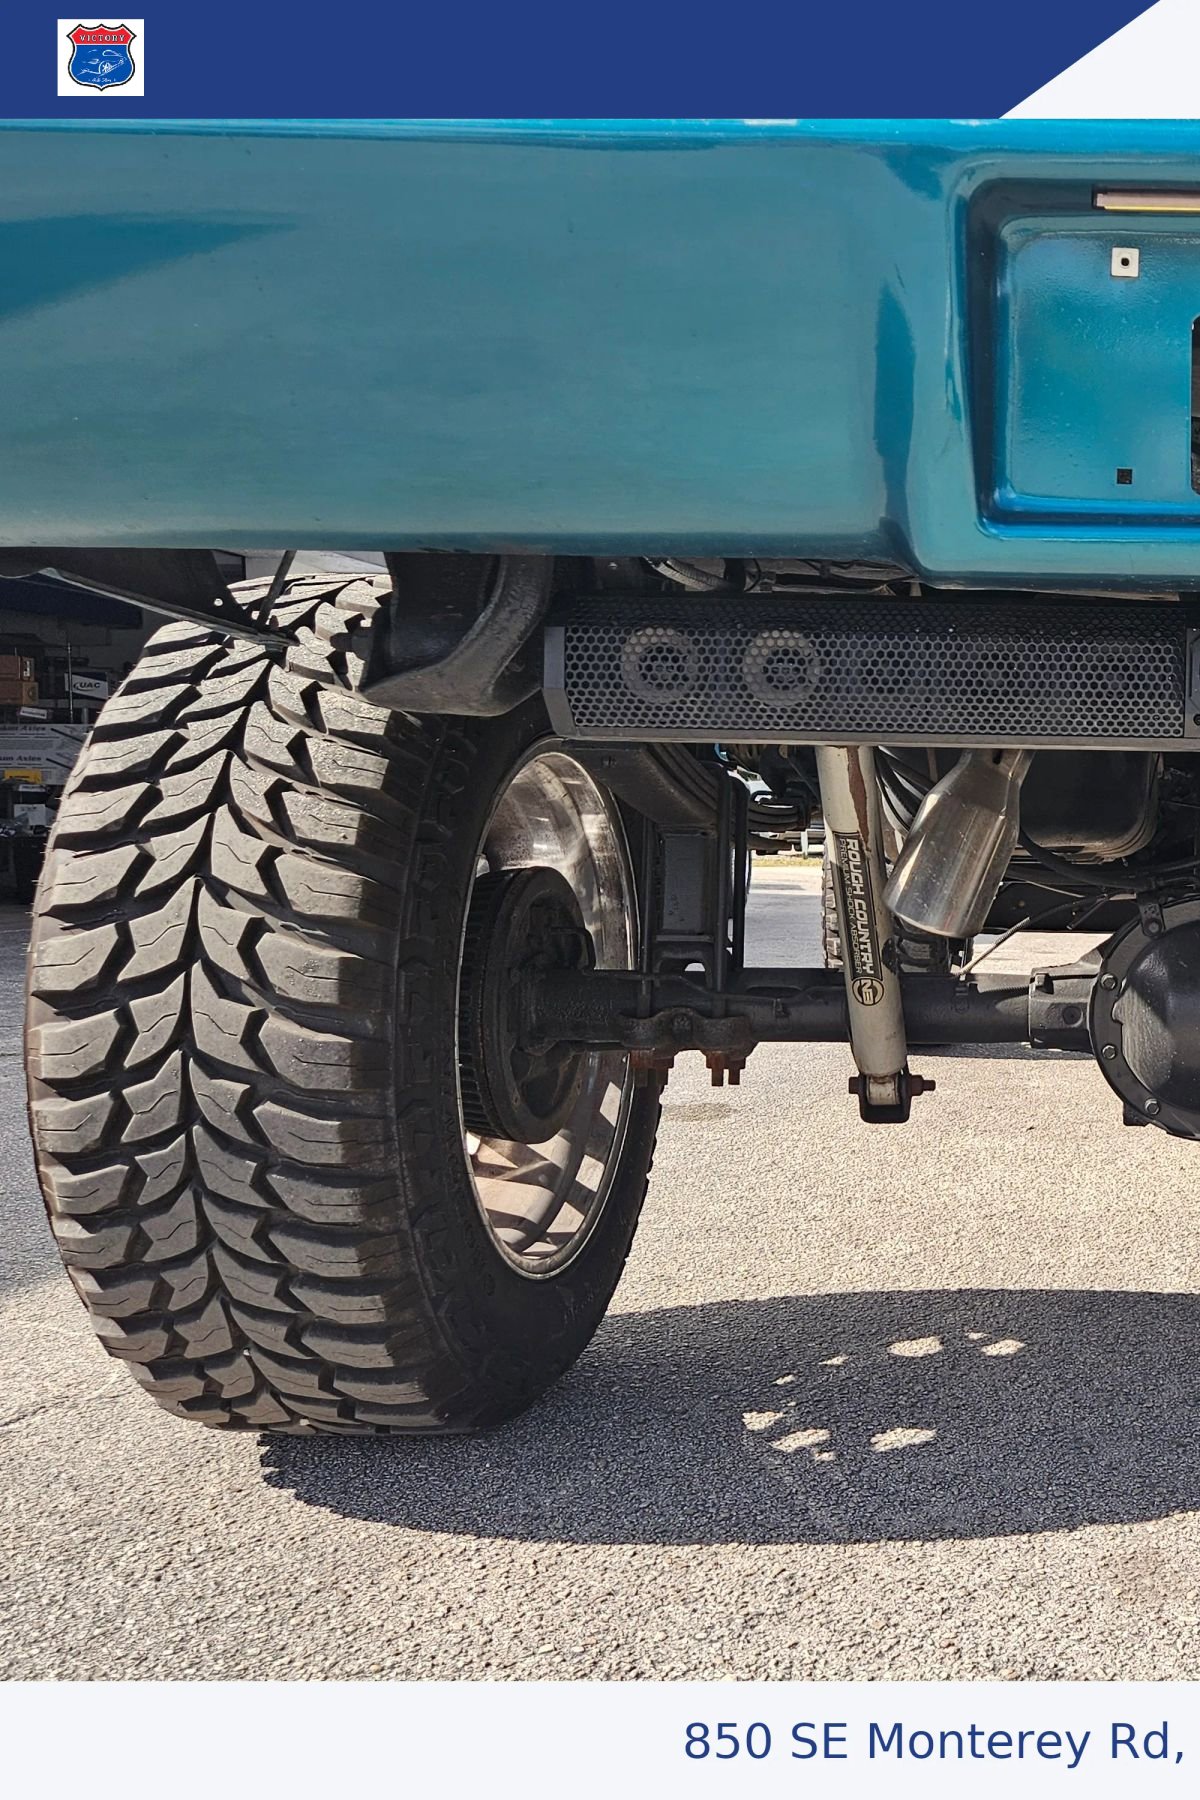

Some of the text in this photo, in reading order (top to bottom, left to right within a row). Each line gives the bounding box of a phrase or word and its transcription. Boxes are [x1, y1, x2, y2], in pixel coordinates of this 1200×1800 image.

[79, 681, 101, 689] UAC
[840, 838, 863, 974] PREMIUM SHOCK ABSORBER
[846, 838, 875, 975] ROUGH COUNTRY
